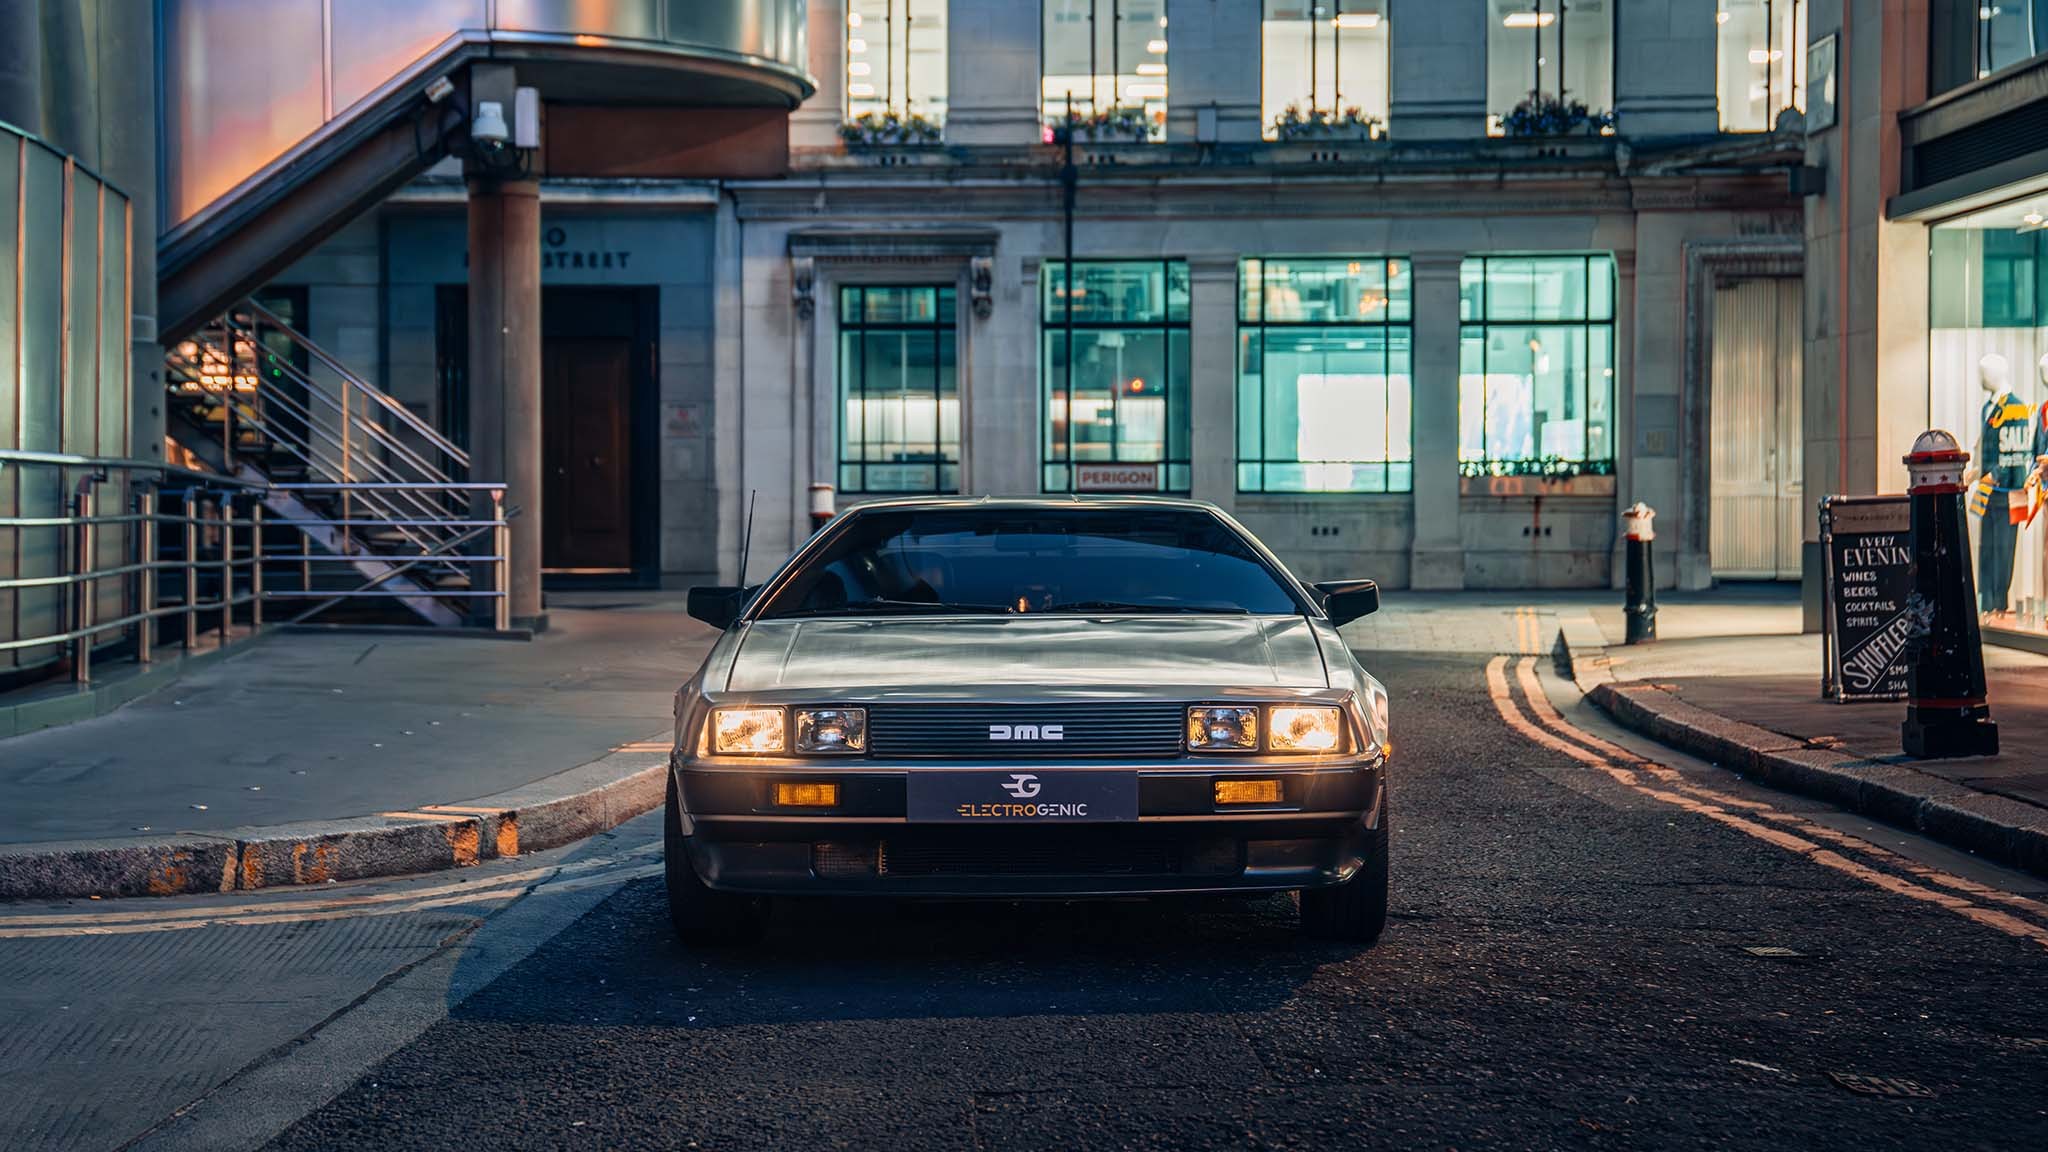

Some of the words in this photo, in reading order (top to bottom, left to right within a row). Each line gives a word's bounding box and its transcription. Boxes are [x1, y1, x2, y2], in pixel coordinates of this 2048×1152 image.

[1082, 471, 1153, 484] PERIGON
[1844, 546, 1911, 566] EVENIN
[1842, 571, 1877, 582] WINES
[1843, 586, 1878, 597] BEERS
[1845, 601, 1897, 613] COCKTAILS
[1846, 616, 1879, 627] SPIRITS
[1889, 665, 1909, 675] SMA
[1888, 680, 1908, 690] SHA
[957, 803, 1088, 817] ELECTROGENIC
